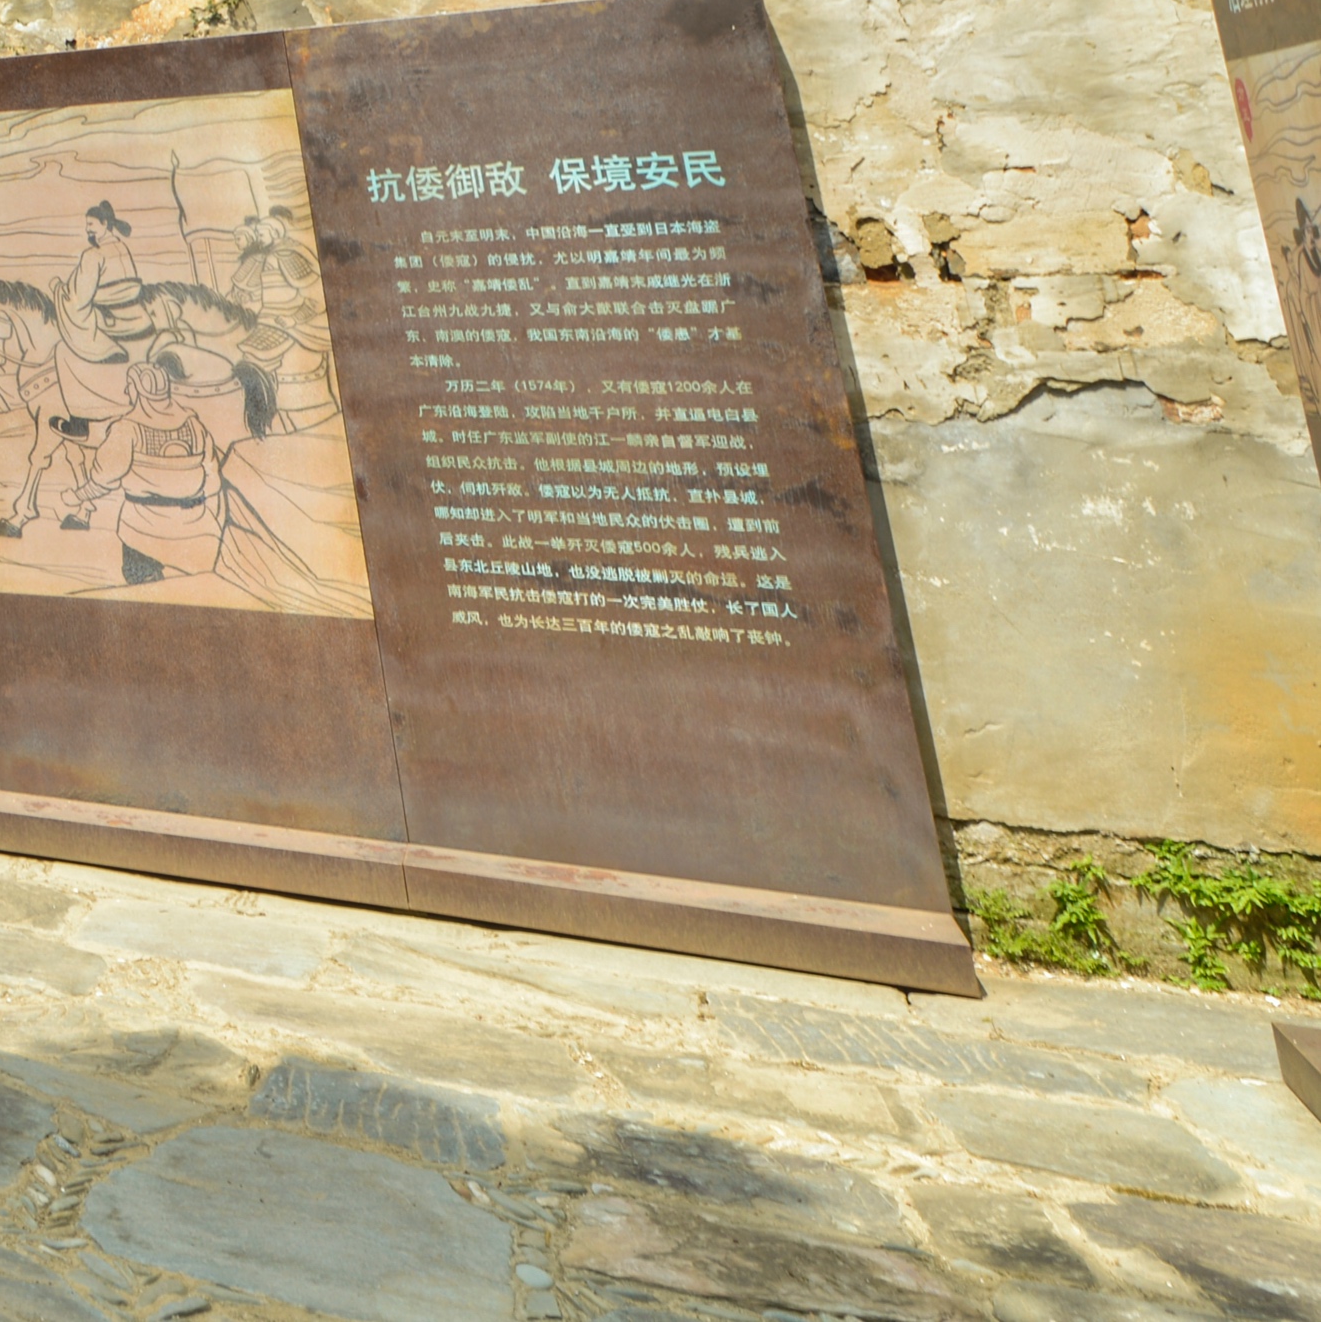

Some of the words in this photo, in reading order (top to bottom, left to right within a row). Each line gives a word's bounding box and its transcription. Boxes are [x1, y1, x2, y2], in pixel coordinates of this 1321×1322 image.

[366, 160, 527, 203] 抗倭御敌
[549, 150, 726, 195] 保境安民
[410, 354, 461, 368] 本清除。
